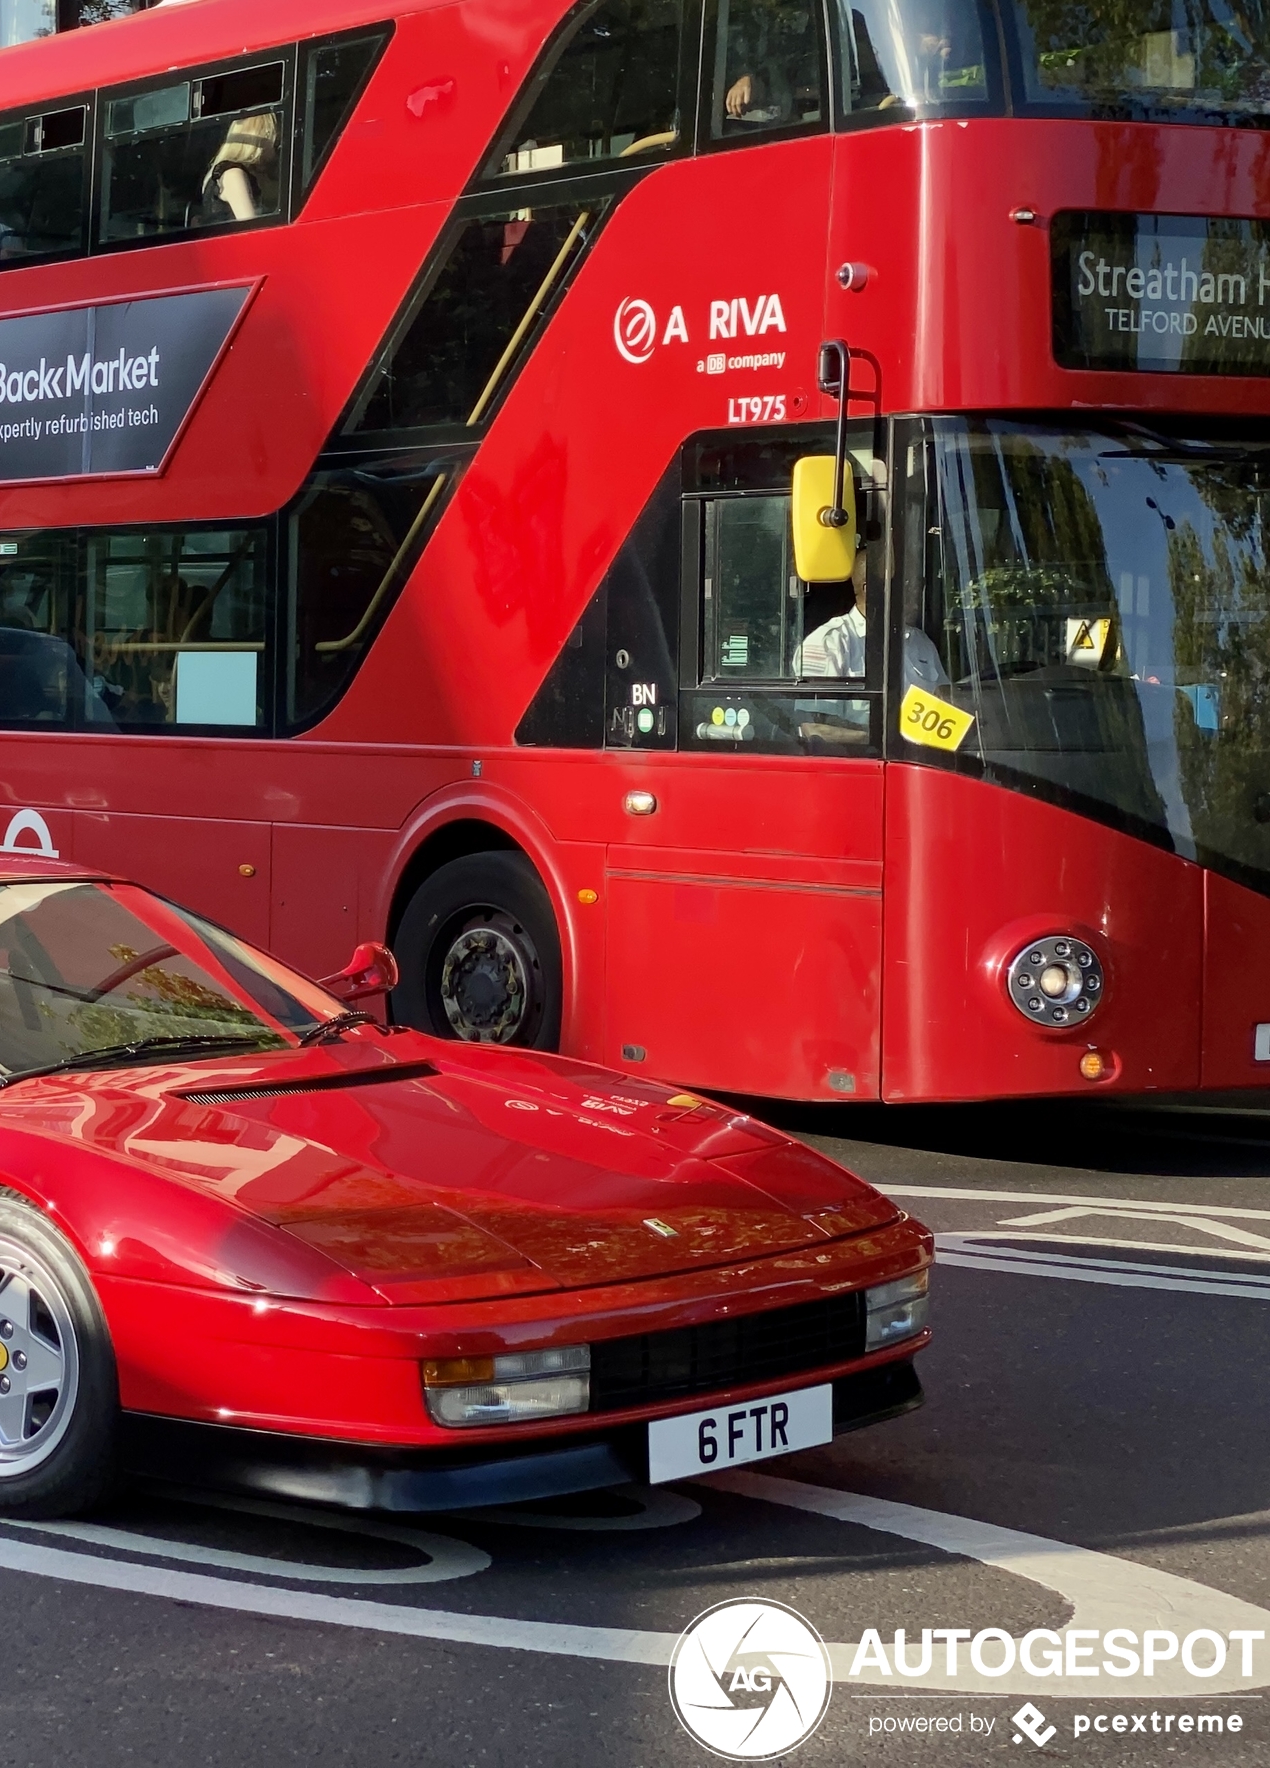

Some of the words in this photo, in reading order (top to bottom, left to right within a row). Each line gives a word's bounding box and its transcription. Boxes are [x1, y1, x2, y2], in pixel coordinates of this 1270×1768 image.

[1078, 251, 1246, 305] Streatham
[1104, 308, 1198, 335] TELFORD
[696, 359, 705, 373] a
[708, 355, 724, 373] DB
[728, 351, 786, 371] company
[45, 407, 125, 435] refurbished
[127, 403, 159, 427] tech
[728, 394, 787, 424] LT975
[632, 683, 656, 706] BN
[907, 702, 957, 740] 306
[698, 1417, 718, 1465] 6
[728, 1401, 789, 1459] FTR
